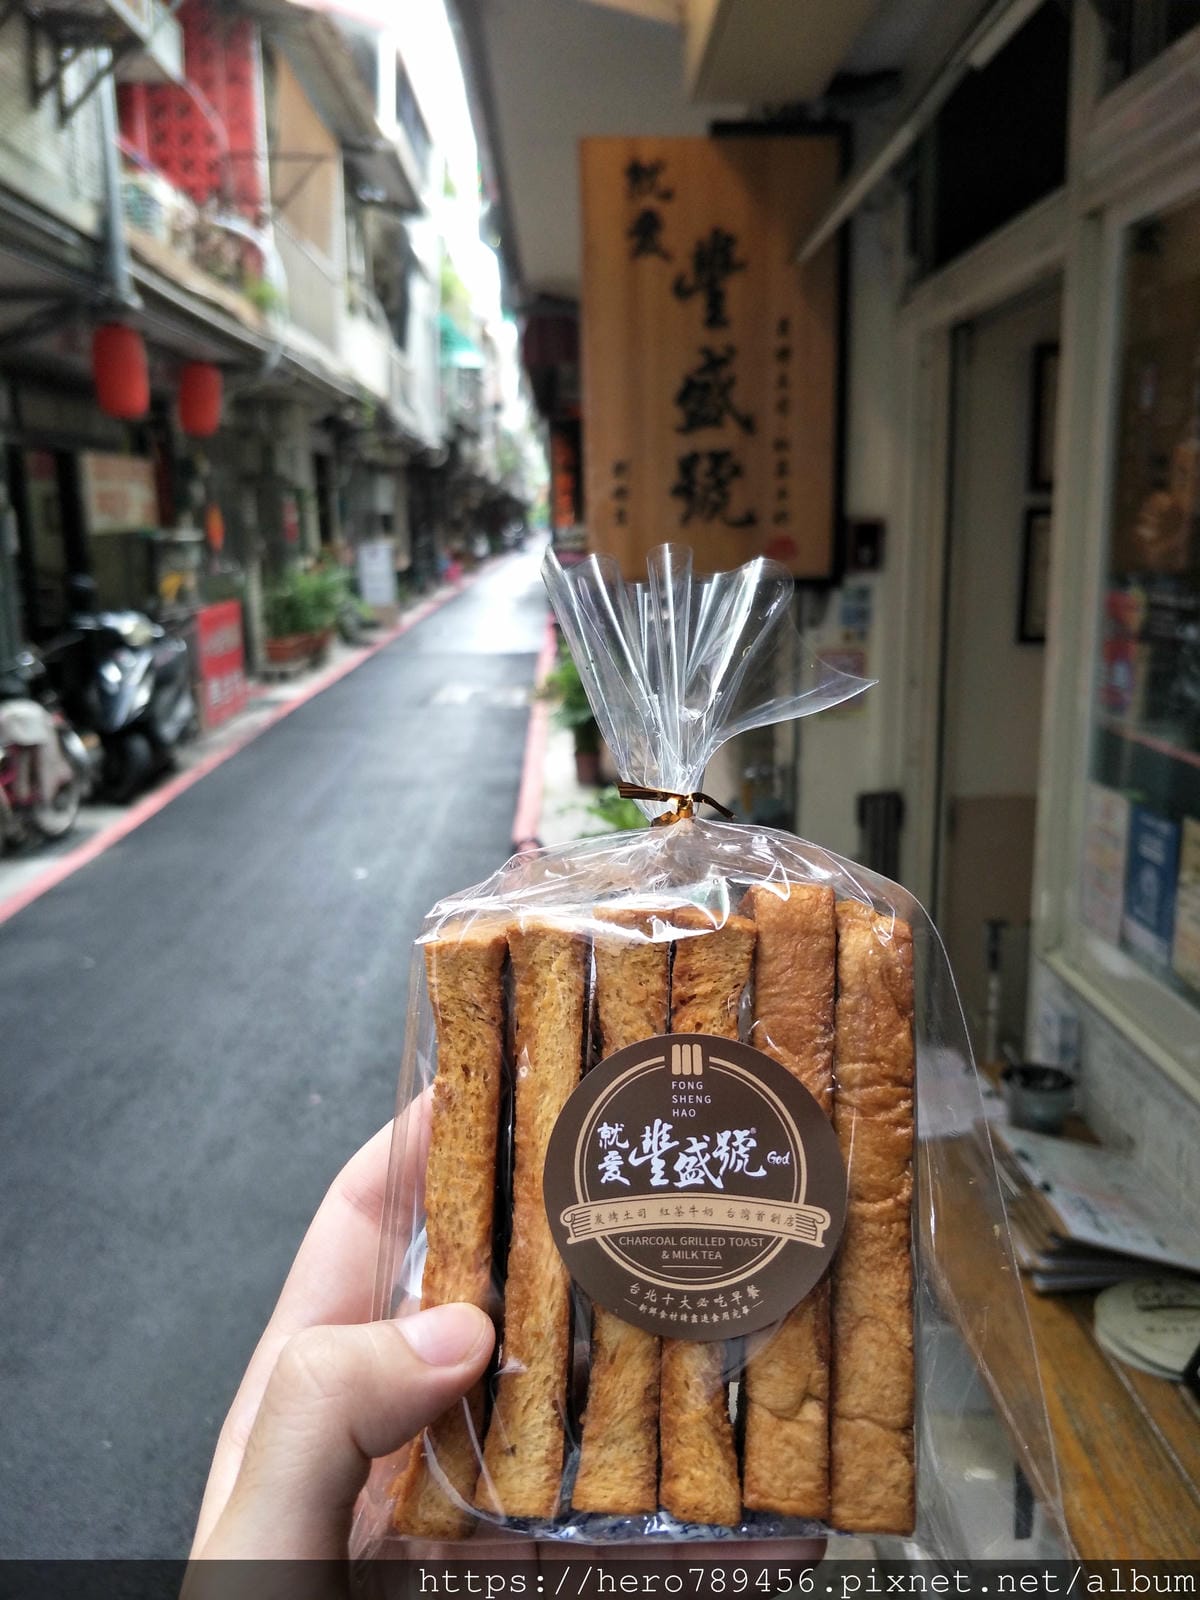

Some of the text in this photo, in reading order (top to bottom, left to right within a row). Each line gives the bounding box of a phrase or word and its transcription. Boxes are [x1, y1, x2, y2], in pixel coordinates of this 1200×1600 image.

[671, 1081, 704, 1090] FONG
[671, 1094, 712, 1104] SHENG
[672, 1108, 697, 1118] HAO
[628, 1118, 768, 1189] 豐盛號
[767, 1150, 791, 1165] God
[594, 1207, 648, 1225] 炭烤土司
[659, 1204, 714, 1219] 紅茶牛奶
[618, 1236, 764, 1247] CHARCOAL GRILLED TOAST
[661, 1250, 722, 1260] & MILK TEA
